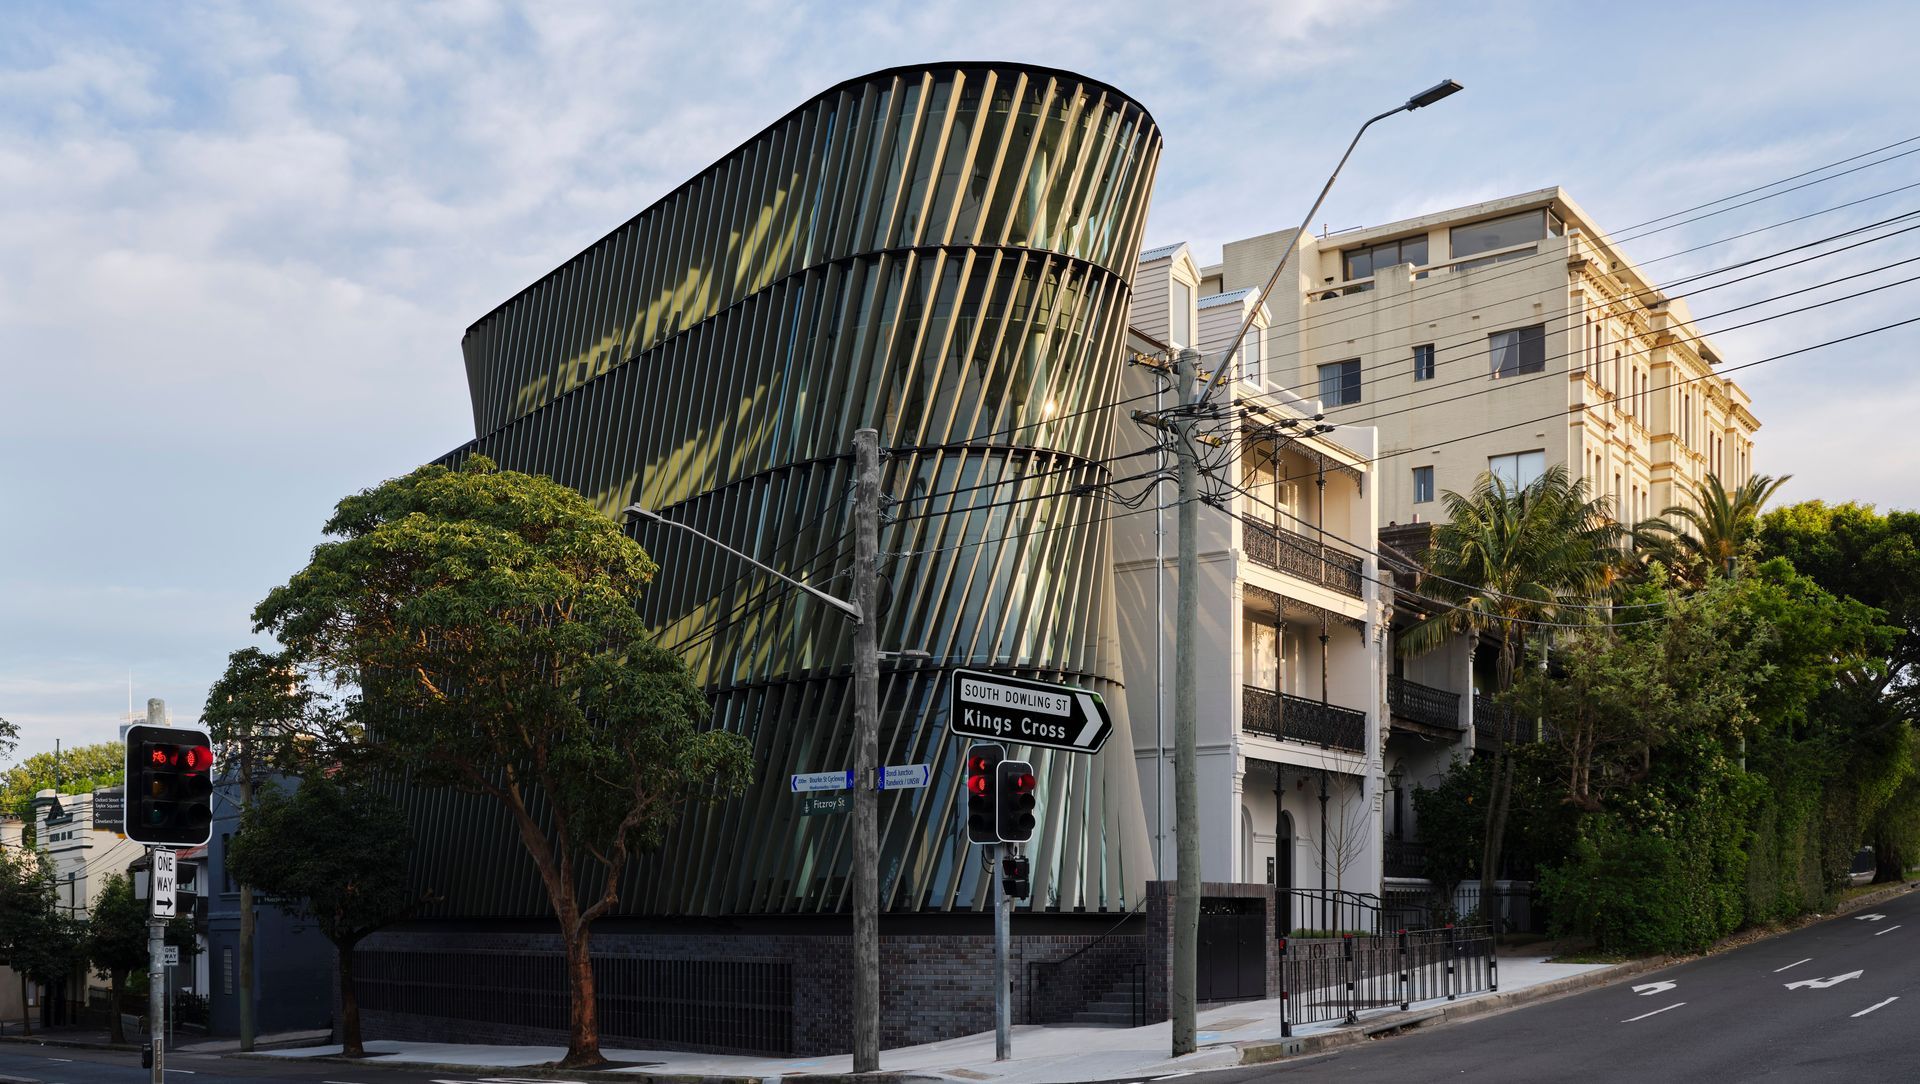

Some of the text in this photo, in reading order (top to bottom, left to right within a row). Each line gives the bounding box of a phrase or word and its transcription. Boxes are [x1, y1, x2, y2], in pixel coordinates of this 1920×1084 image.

[964, 684, 1068, 711] SOUTH DOWLING ST
[964, 708, 1066, 739] Kings Cross
[828, 775, 845, 784] Cycleway
[886, 769, 914, 777] Bondi Junction
[813, 797, 846, 810] Fitzroy St
[157, 856, 173, 872] ONE
[156, 876, 174, 892] WAY
